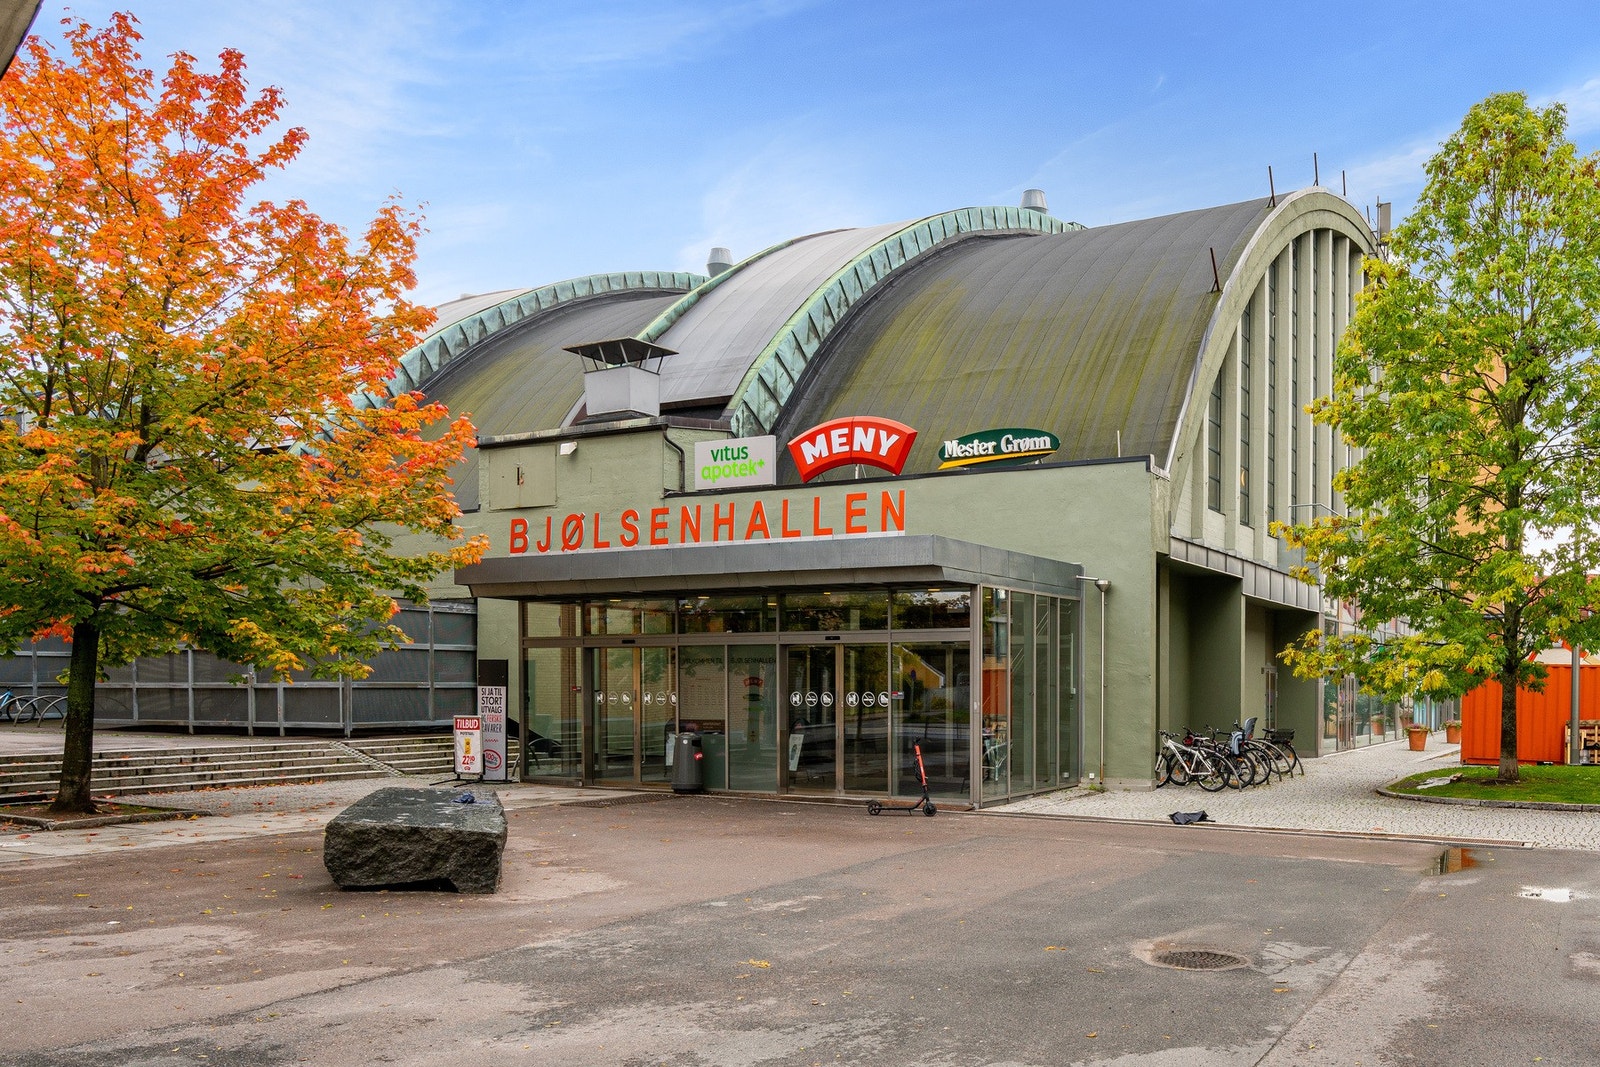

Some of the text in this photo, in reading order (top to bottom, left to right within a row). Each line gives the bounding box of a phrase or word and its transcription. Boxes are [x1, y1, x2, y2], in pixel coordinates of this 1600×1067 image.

[800, 426, 900, 465] MENY
[943, 434, 1052, 458] Mester Grønn
[710, 445, 748, 462] vitus
[509, 489, 906, 554] BJØLSENHALLEN
[494, 688, 502, 696] TIL
[481, 696, 502, 705] STORT
[481, 705, 502, 714] UTVALG
[456, 719, 478, 729] TILBUD
